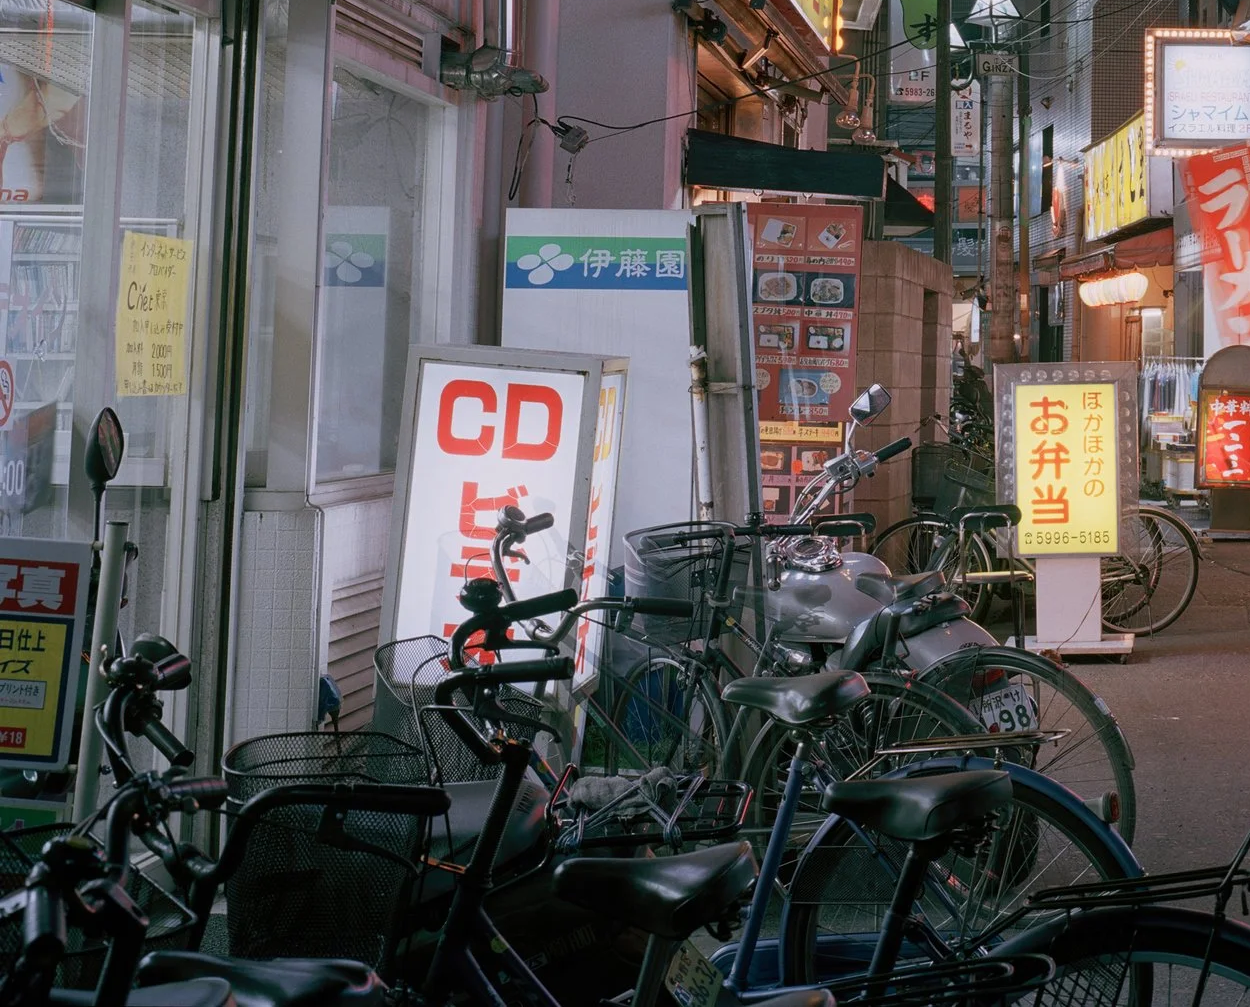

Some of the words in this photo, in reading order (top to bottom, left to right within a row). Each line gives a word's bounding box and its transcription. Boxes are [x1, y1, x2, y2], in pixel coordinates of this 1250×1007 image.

[982, 61, 1015, 73] GINZA
[1171, 104, 1248, 122] シャマイム
[1168, 124, 1236, 134] イスラエル料理
[579, 248, 686, 281] 伊藤園
[437, 379, 563, 461] CD
[1029, 396, 1071, 525] お弁当
[1222, 420, 1246, 478] 一二三
[1036, 531, 1110, 545] 5996-5185
